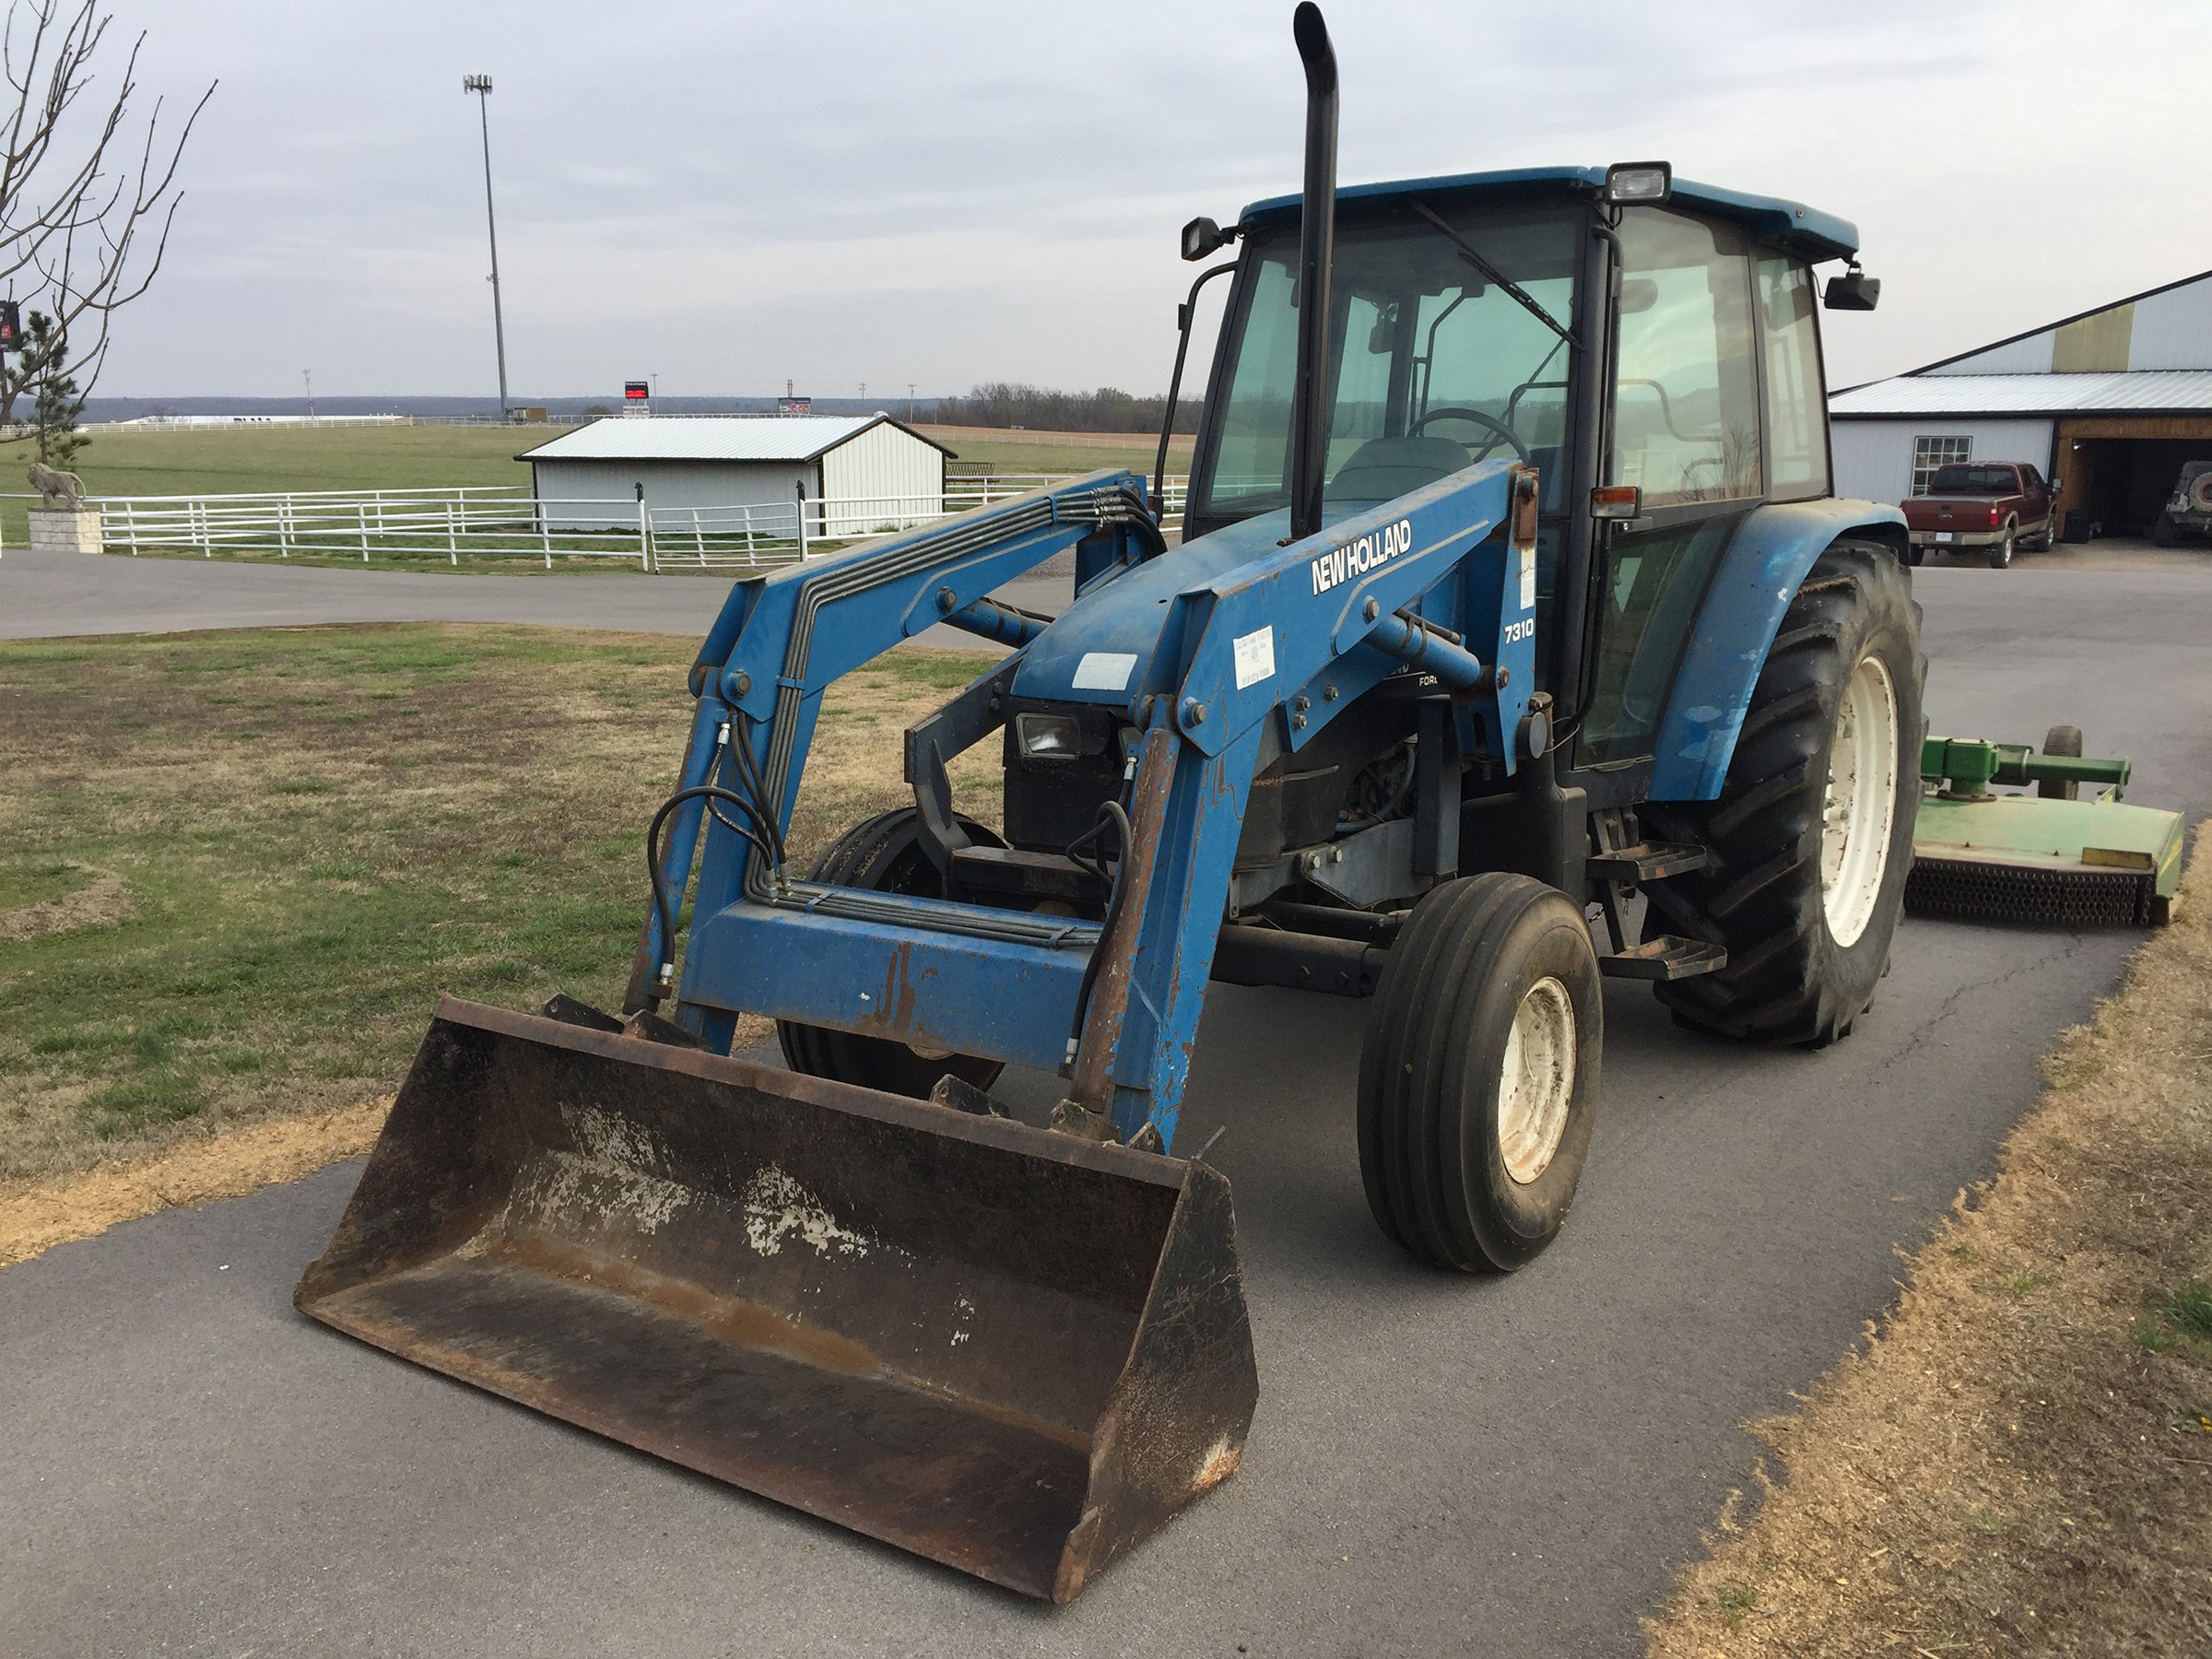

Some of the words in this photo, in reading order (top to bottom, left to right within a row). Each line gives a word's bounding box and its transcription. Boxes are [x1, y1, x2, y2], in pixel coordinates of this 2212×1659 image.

[1312, 547, 1345, 596] NEW
[1347, 519, 1412, 580] HOLLAND
[1505, 618, 1535, 644] 7310
